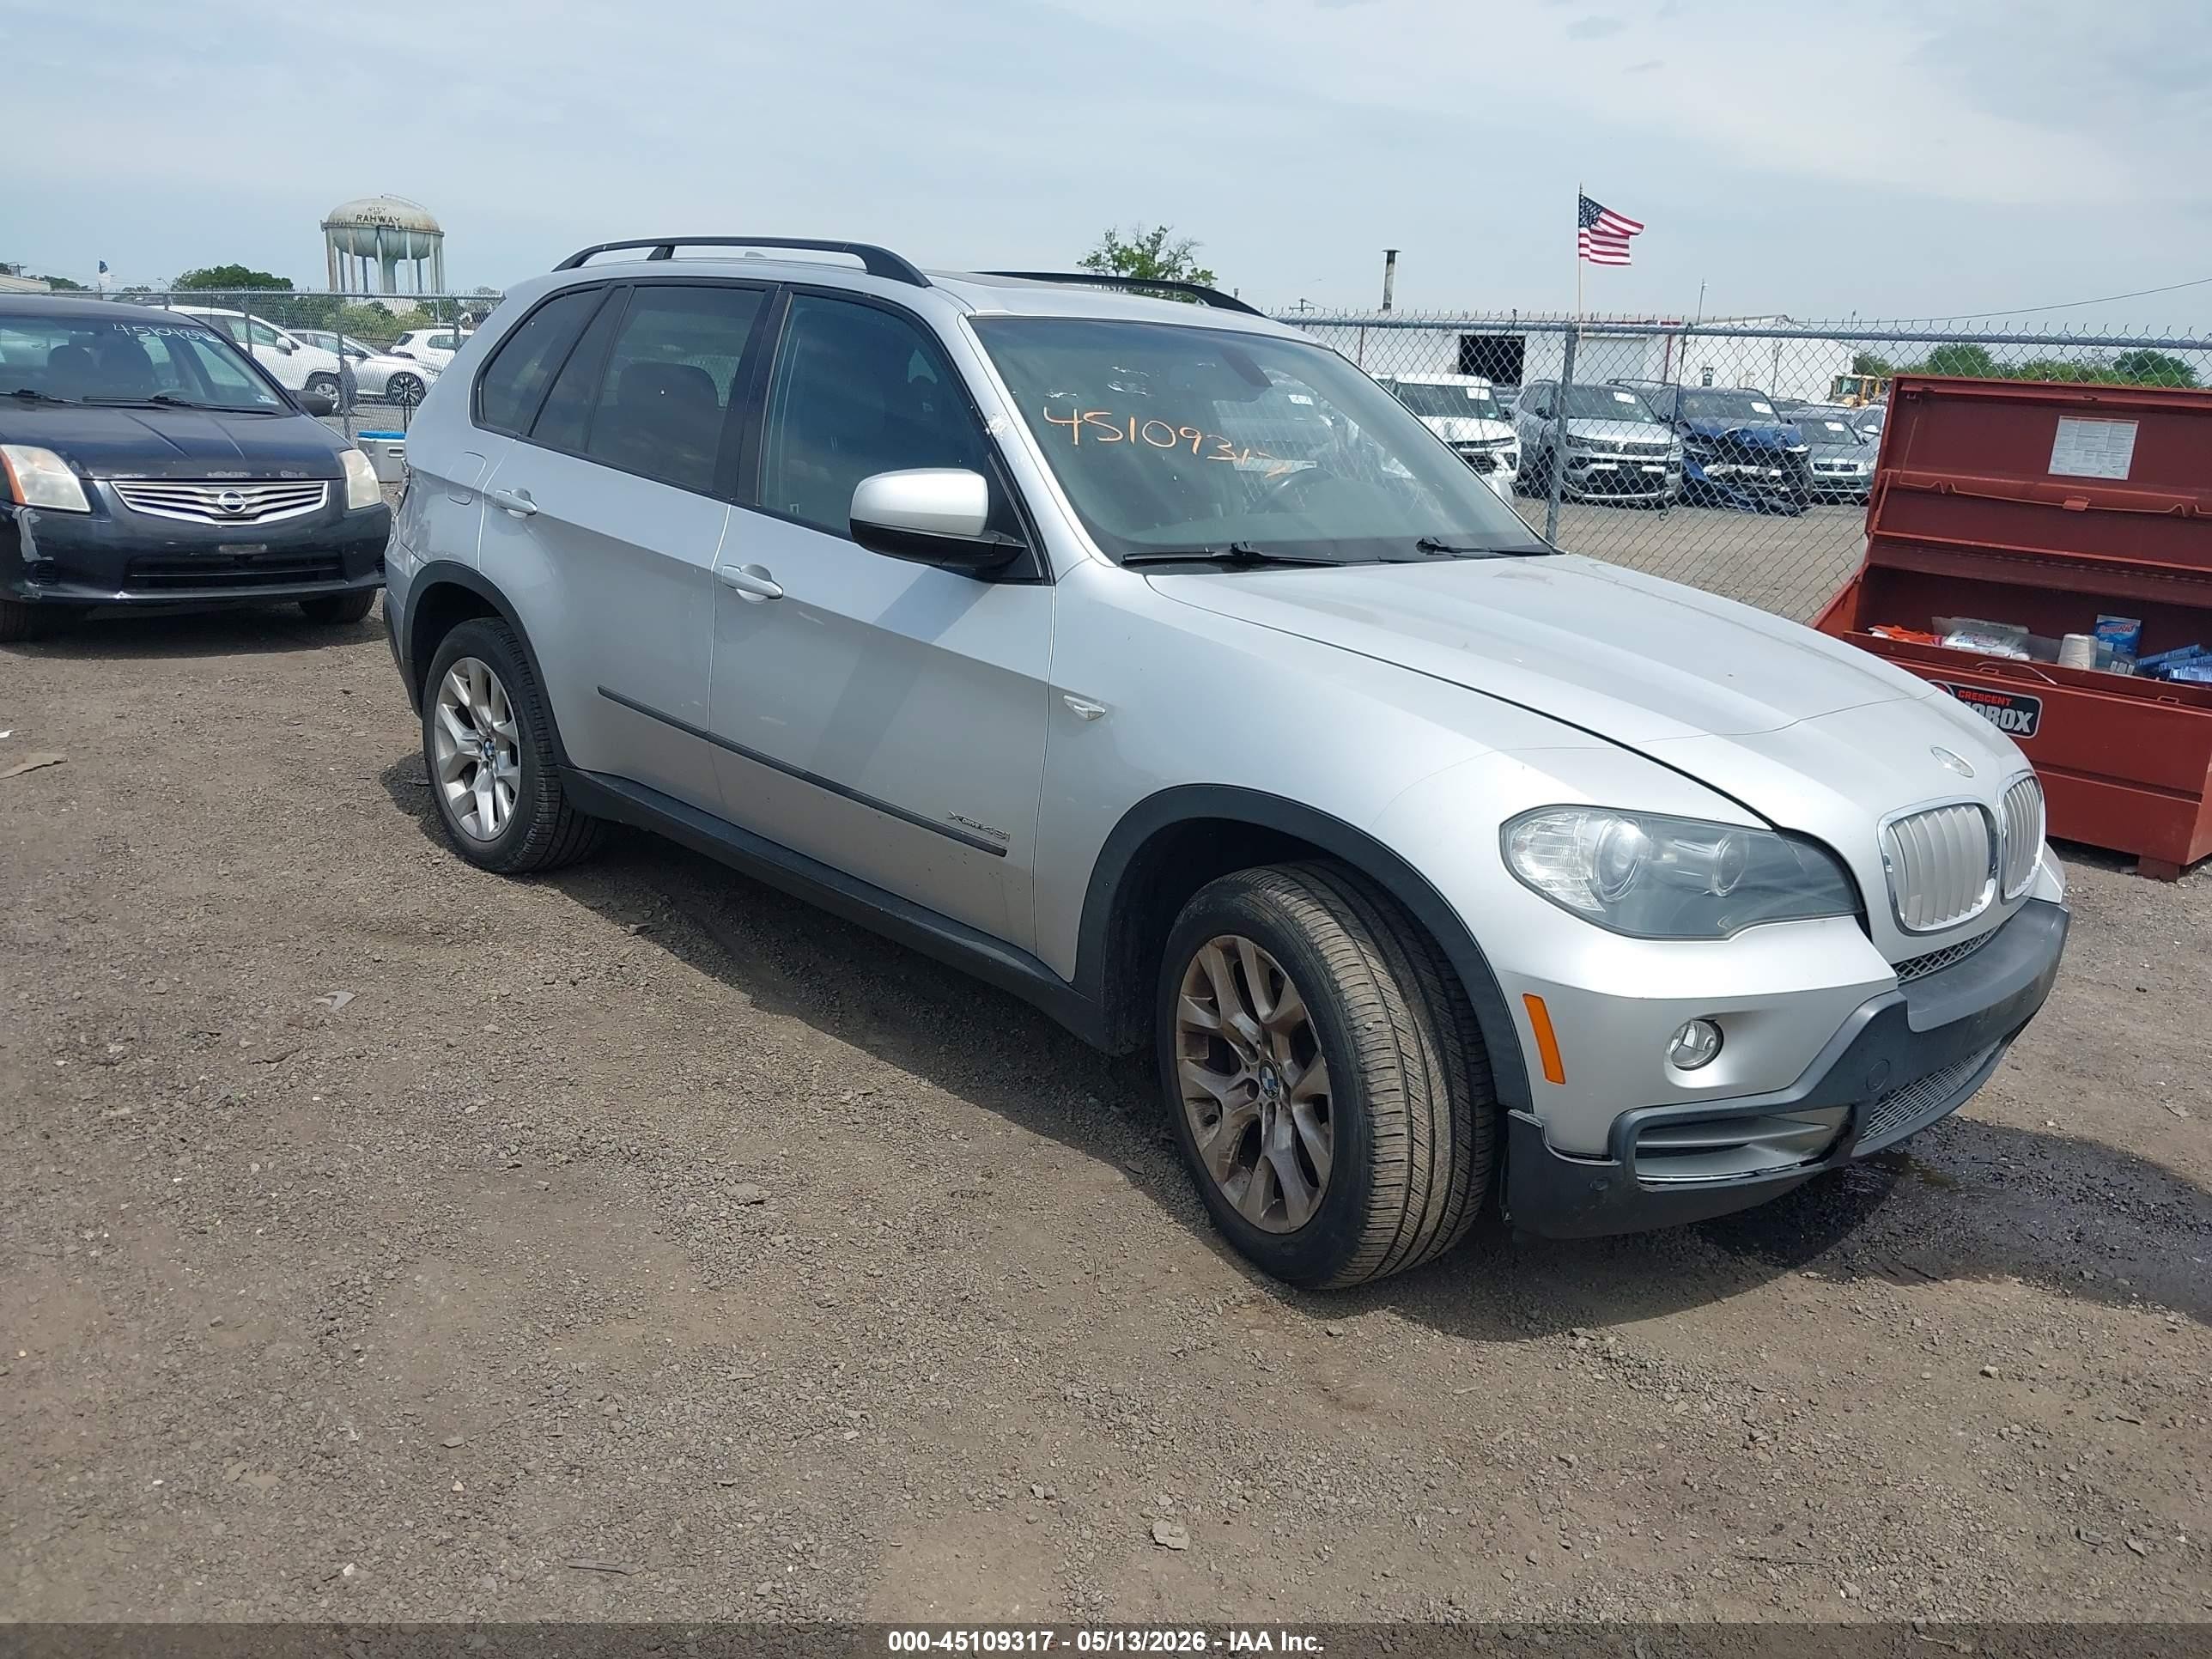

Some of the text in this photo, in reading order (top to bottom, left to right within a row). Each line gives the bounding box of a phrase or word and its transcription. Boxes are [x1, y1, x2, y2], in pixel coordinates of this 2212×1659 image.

[356, 214, 400, 224] RAHWAY
[1042, 406, 1287, 478] 45109317
[1958, 690, 2012, 707] CRESCENT
[1963, 696, 2034, 733] BOX
